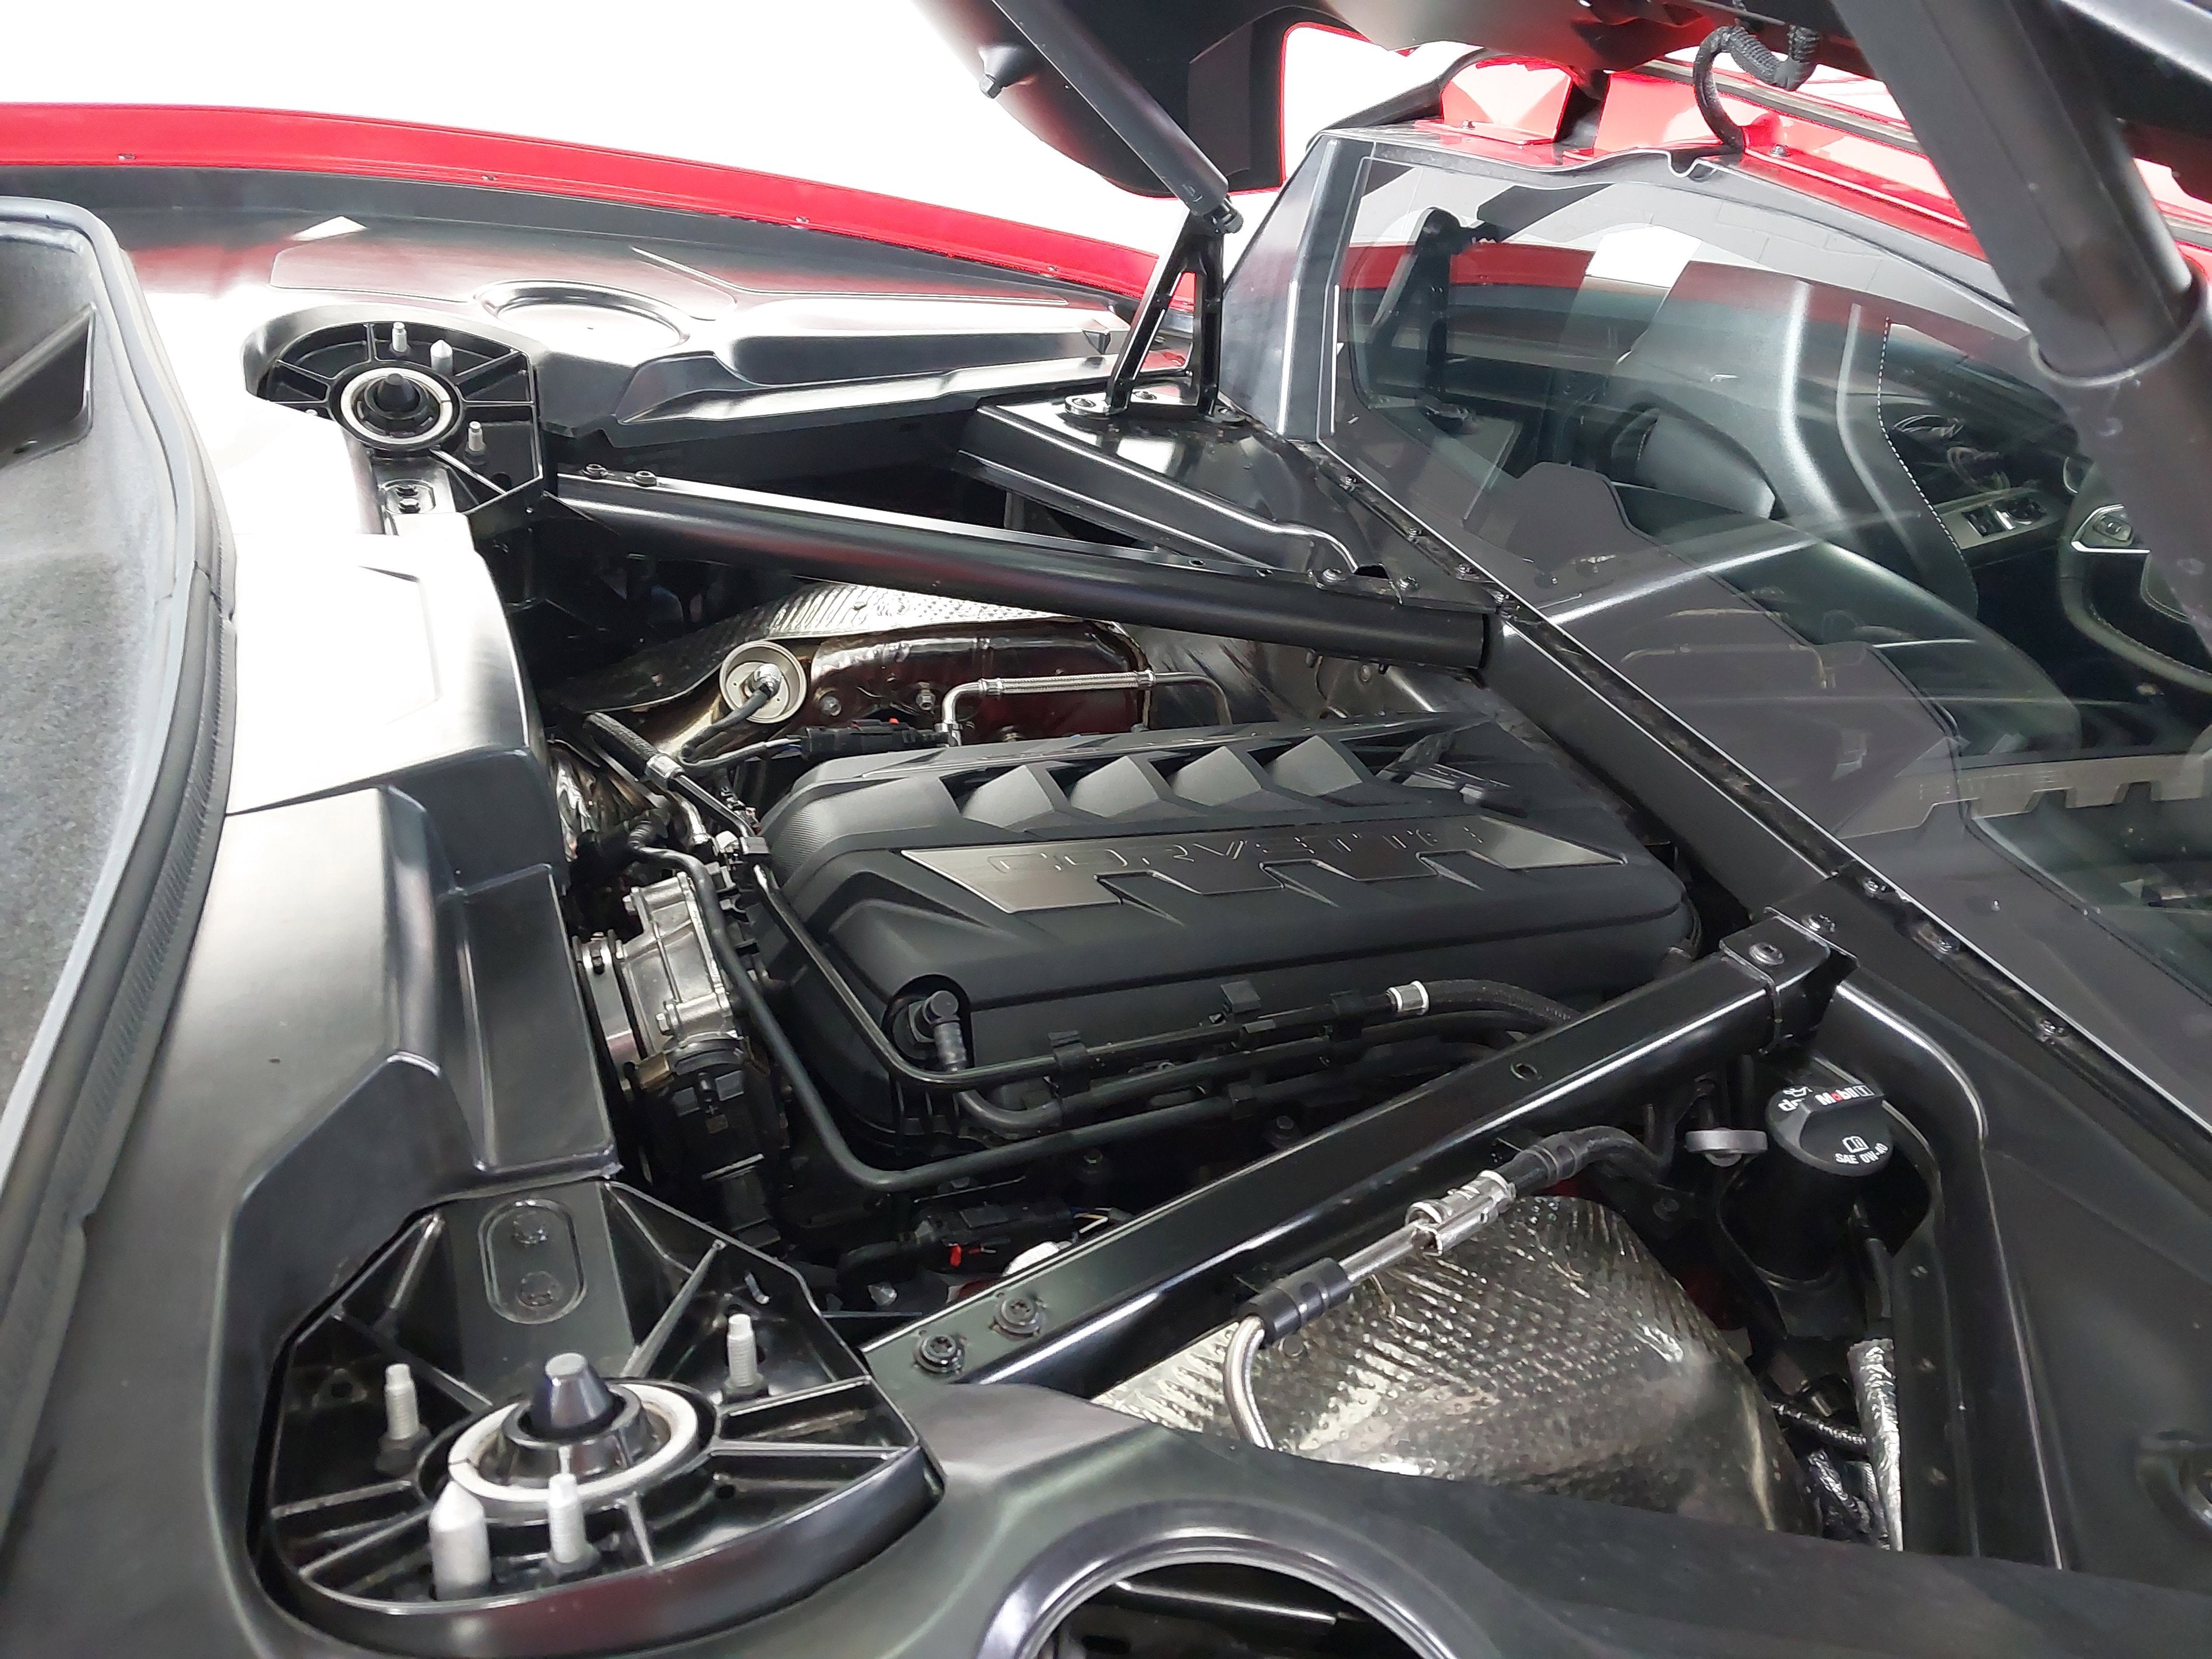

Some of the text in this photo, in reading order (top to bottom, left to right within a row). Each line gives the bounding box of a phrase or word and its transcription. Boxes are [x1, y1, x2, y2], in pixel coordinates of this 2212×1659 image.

[1815, 1087, 1860, 1105] Mobil
[1835, 1142, 1888, 1164] SAE 0W-40
